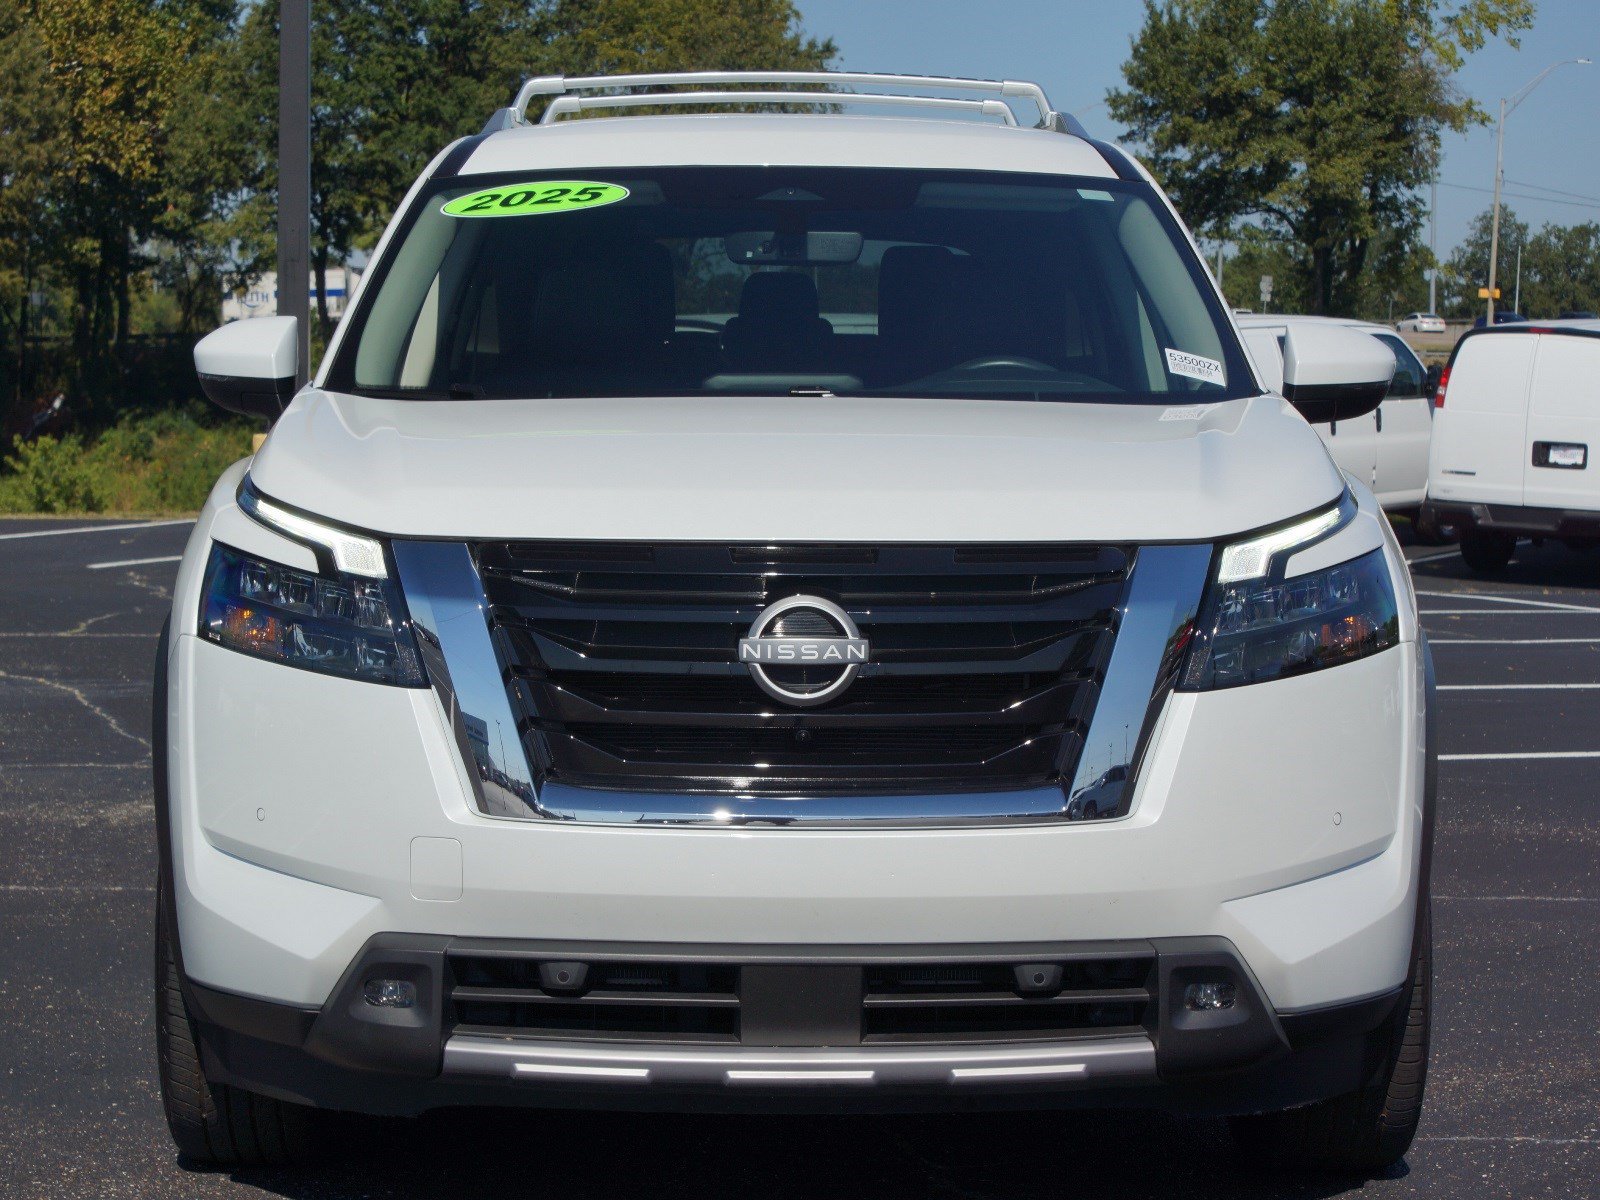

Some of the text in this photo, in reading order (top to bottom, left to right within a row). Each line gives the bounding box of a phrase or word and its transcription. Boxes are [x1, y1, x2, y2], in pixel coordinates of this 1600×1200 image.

[460, 186, 609, 213] 2025
[1169, 352, 1221, 373] 53500ZX
[742, 643, 865, 660] NISSAN
